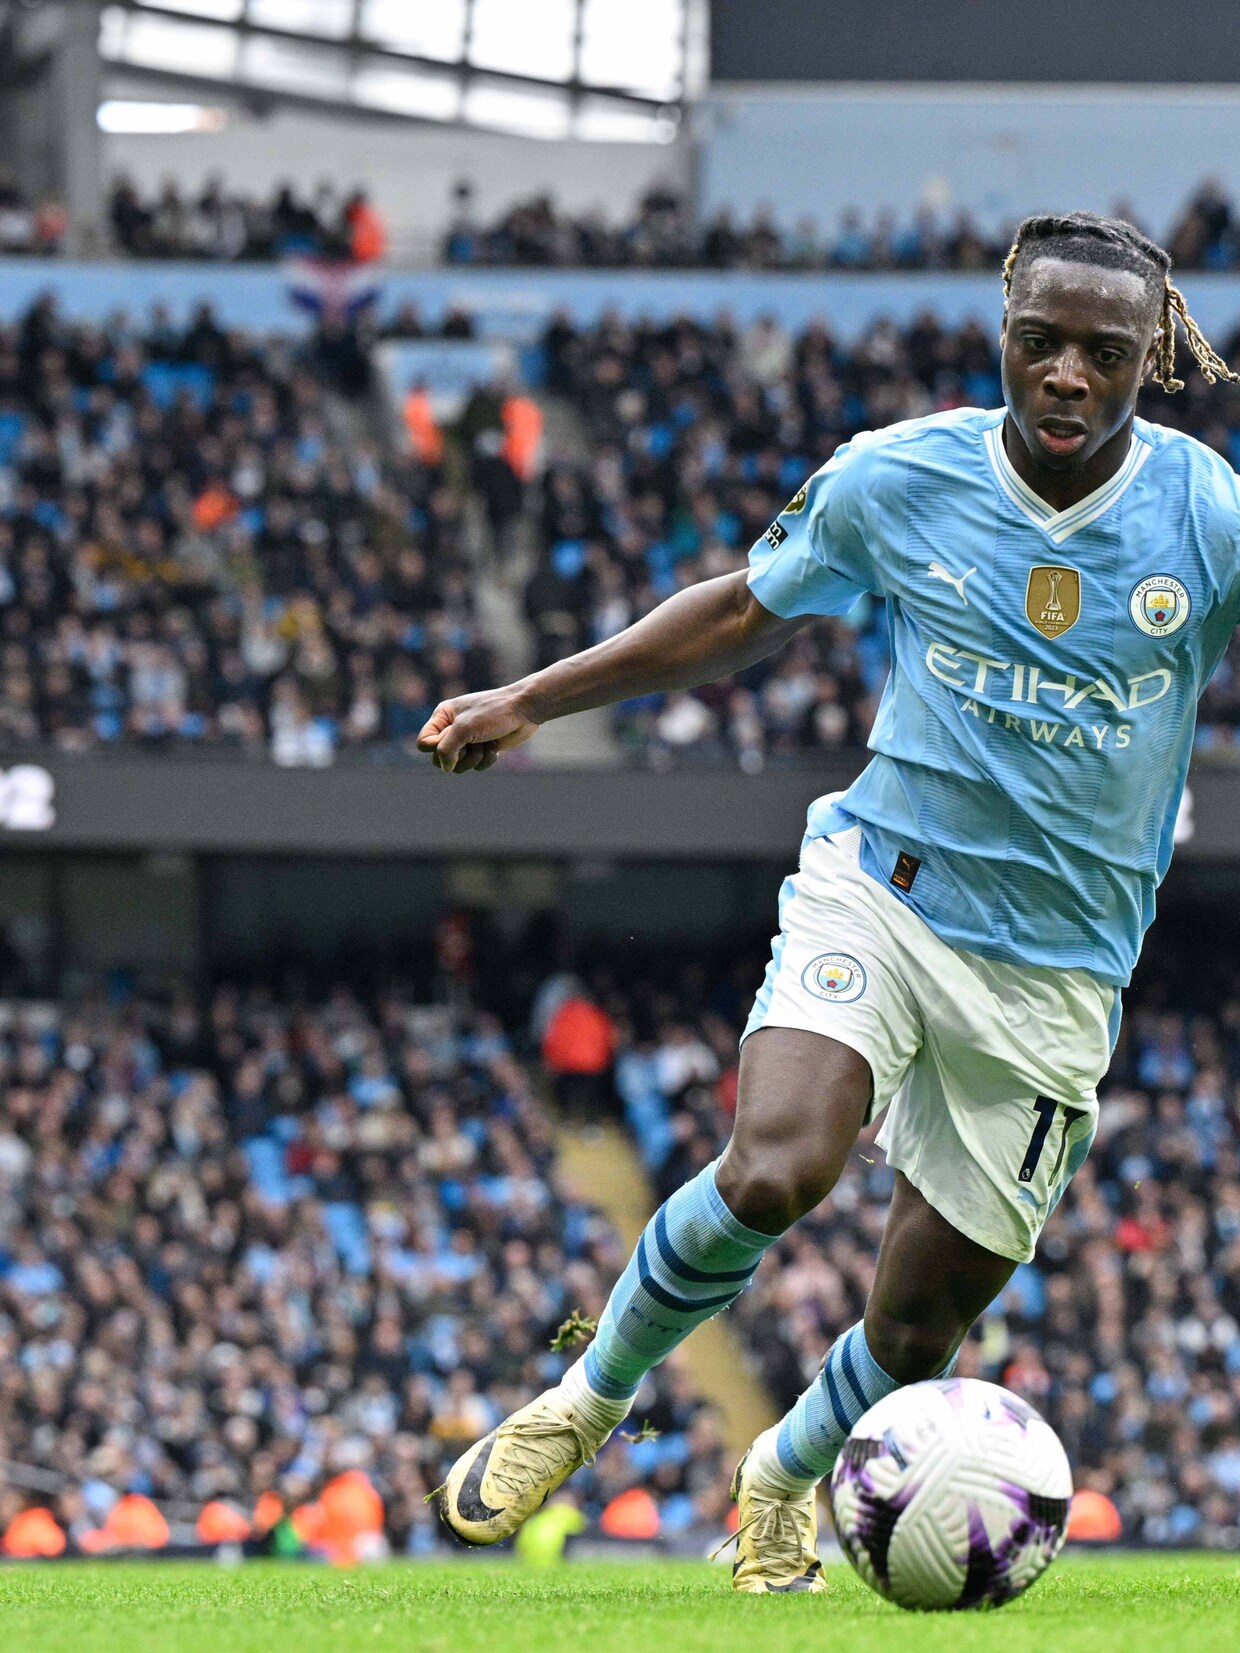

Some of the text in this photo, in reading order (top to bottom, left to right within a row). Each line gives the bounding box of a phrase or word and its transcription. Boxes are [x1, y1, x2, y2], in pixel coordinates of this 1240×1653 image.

[1135, 578, 1185, 599] MANCHESTER
[1040, 611, 1065, 621] FIFA
[925, 641, 1172, 712] ETIHAD
[960, 697, 1132, 749] AIRWAYS
[812, 957, 862, 979] MANCHESTER
[820, 991, 838, 999] CITY
